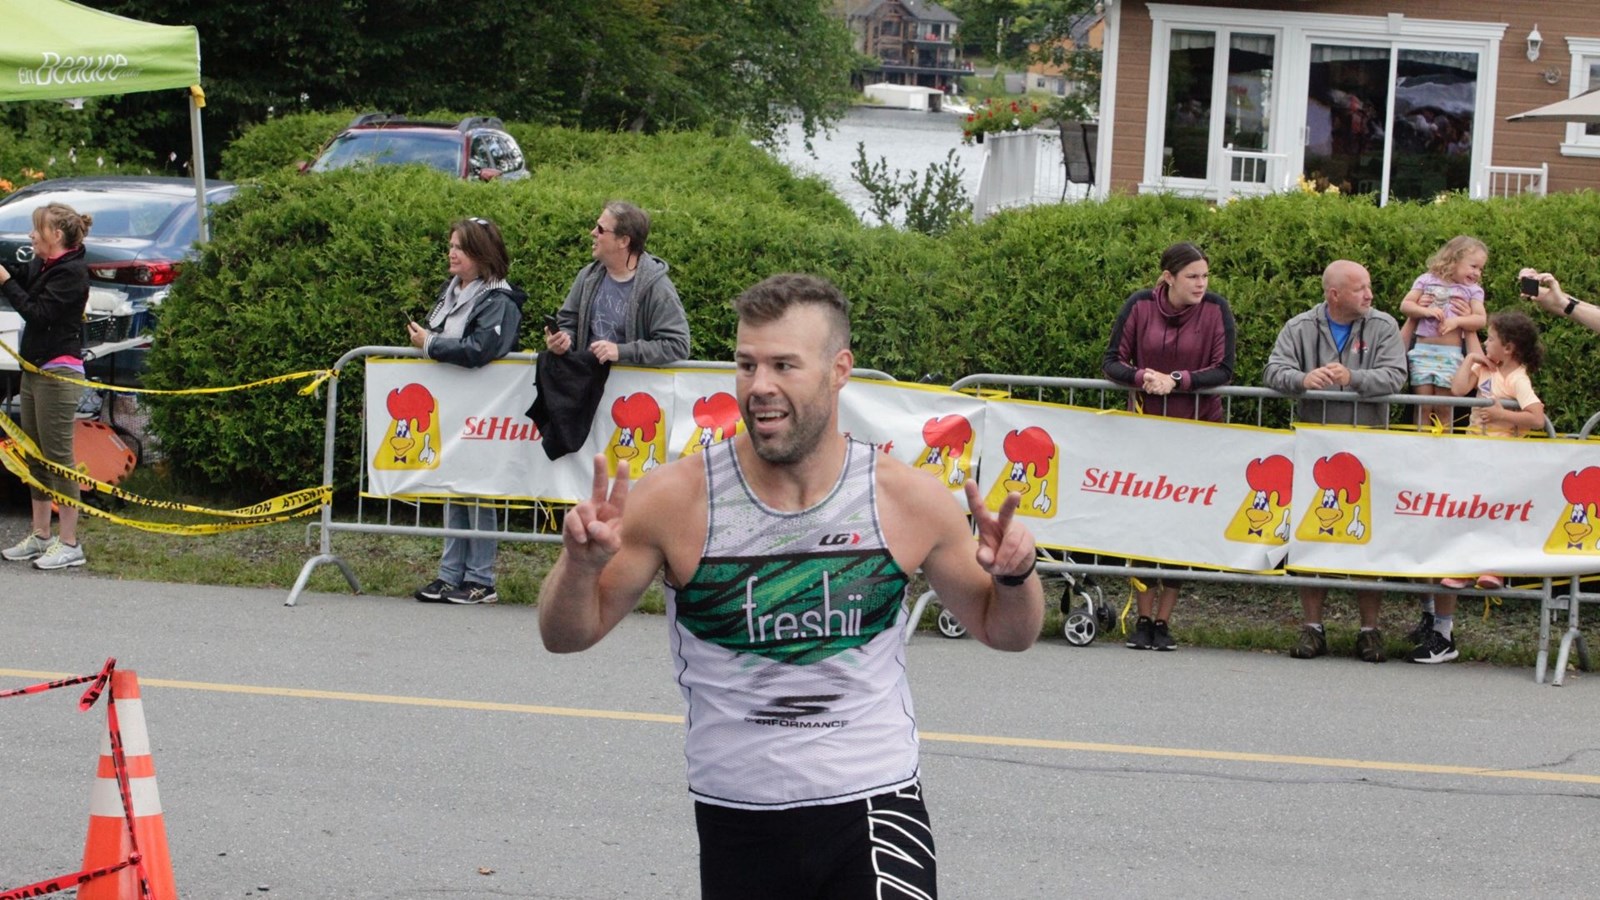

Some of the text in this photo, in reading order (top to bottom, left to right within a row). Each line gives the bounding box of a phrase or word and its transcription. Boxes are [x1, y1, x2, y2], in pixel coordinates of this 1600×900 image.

[461, 416, 543, 441] StHub
[1081, 467, 1218, 505] StHubert
[1394, 490, 1534, 521] StHubert
[741, 571, 862, 643] freshii
